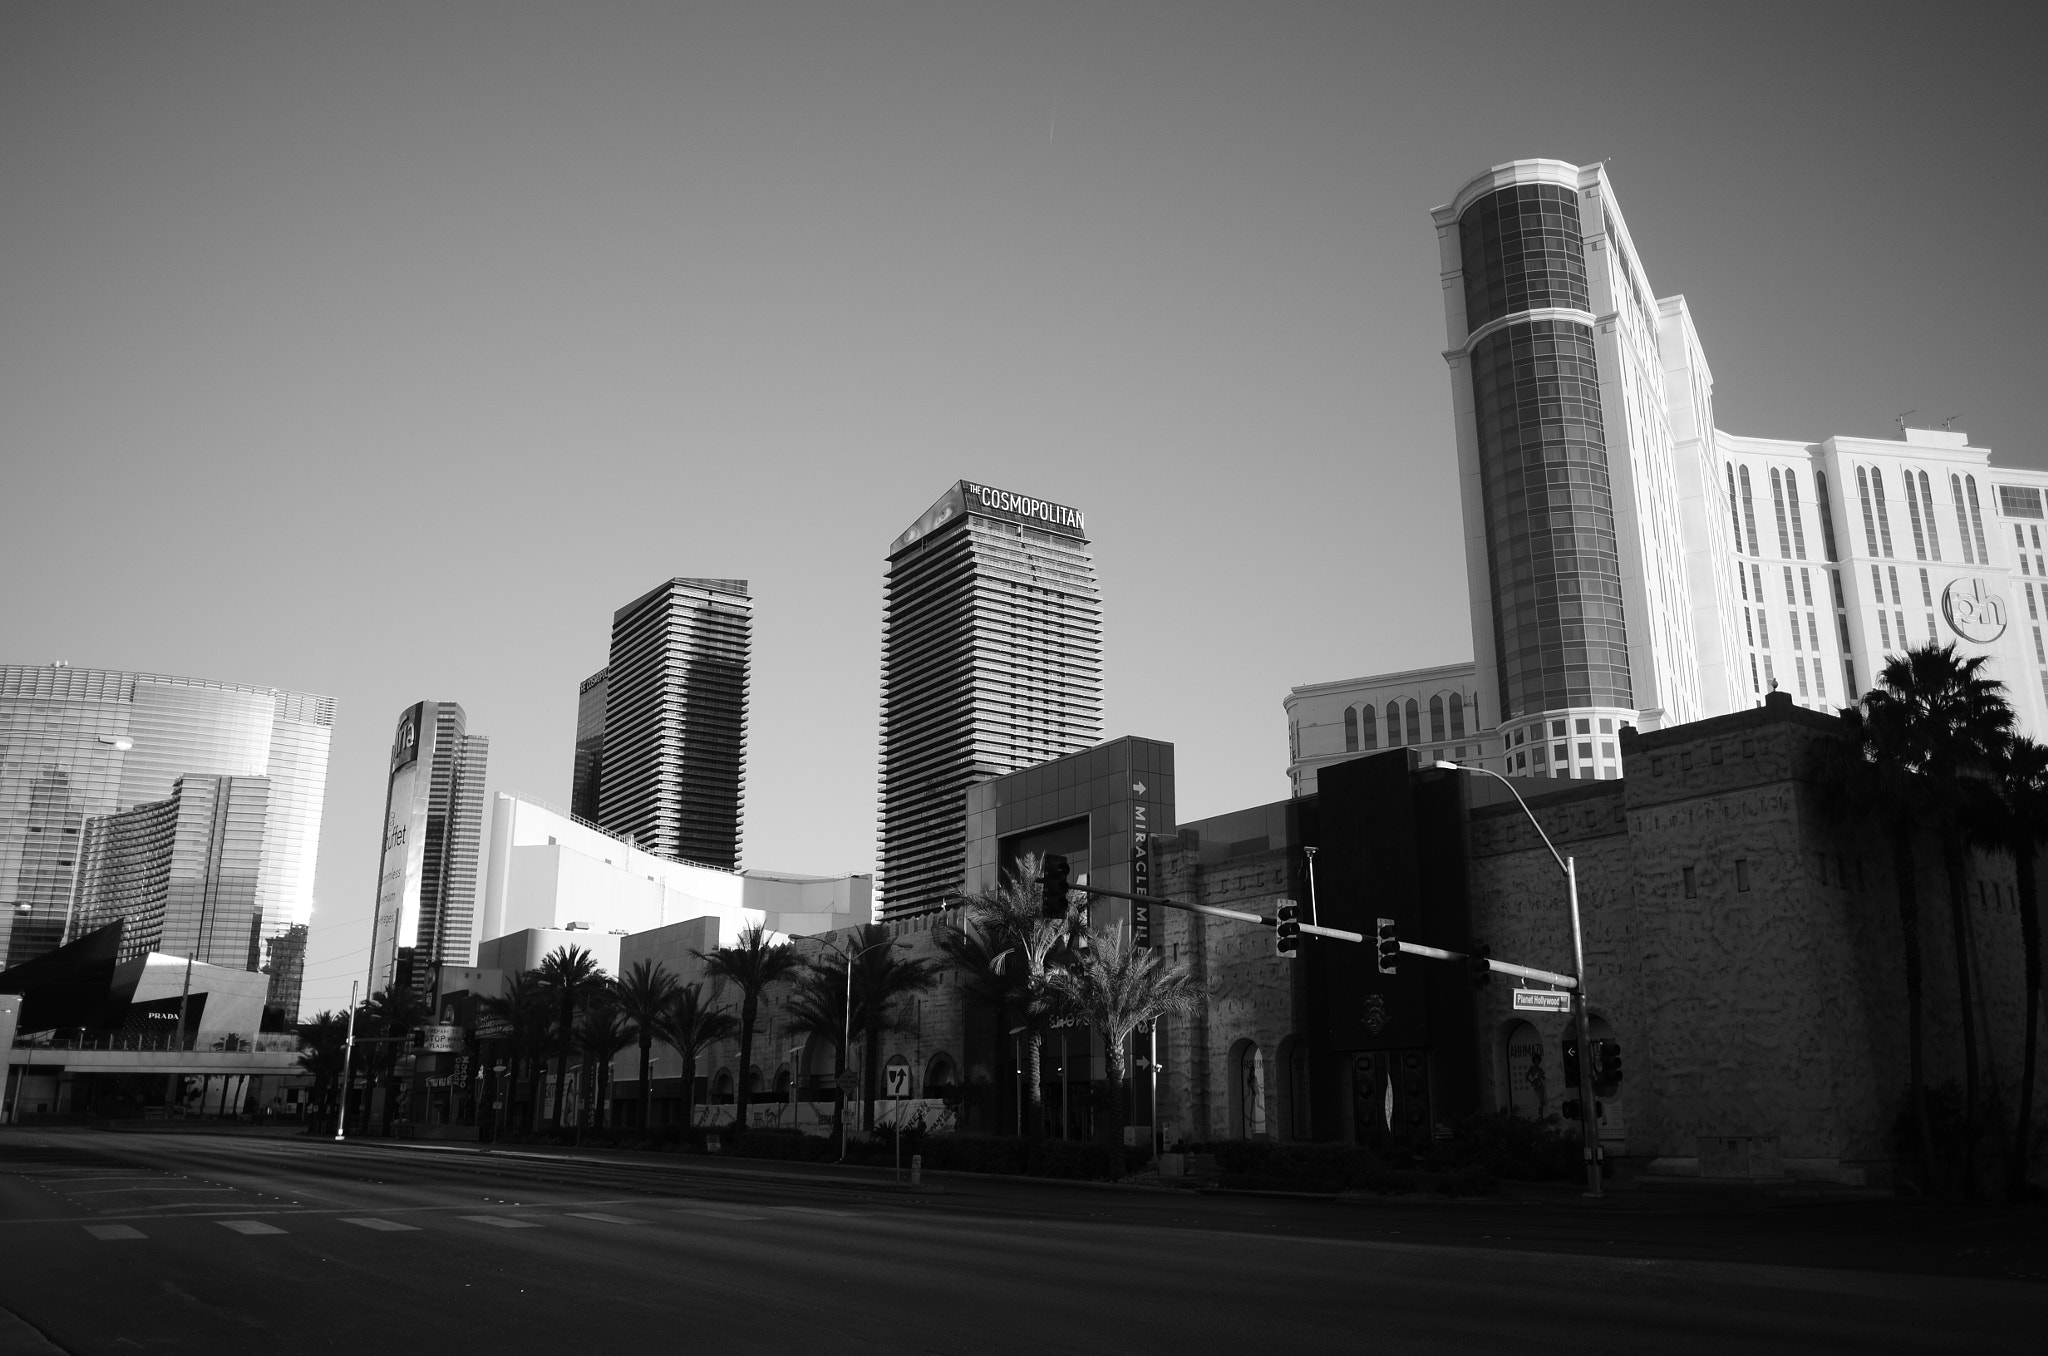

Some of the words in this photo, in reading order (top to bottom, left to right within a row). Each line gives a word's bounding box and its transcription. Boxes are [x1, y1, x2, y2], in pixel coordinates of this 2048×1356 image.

[969, 483, 981, 495] THE
[982, 487, 1085, 530] COSMOPOLITAN
[1135, 806, 1147, 897] MIRACLE
[1136, 907, 1148, 955] MILE
[148, 1012, 179, 1020] PRADA
[1517, 994, 1534, 1005] Planet
[1534, 995, 1560, 1007] Hollywood
[460, 1055, 470, 1088] Nacho
